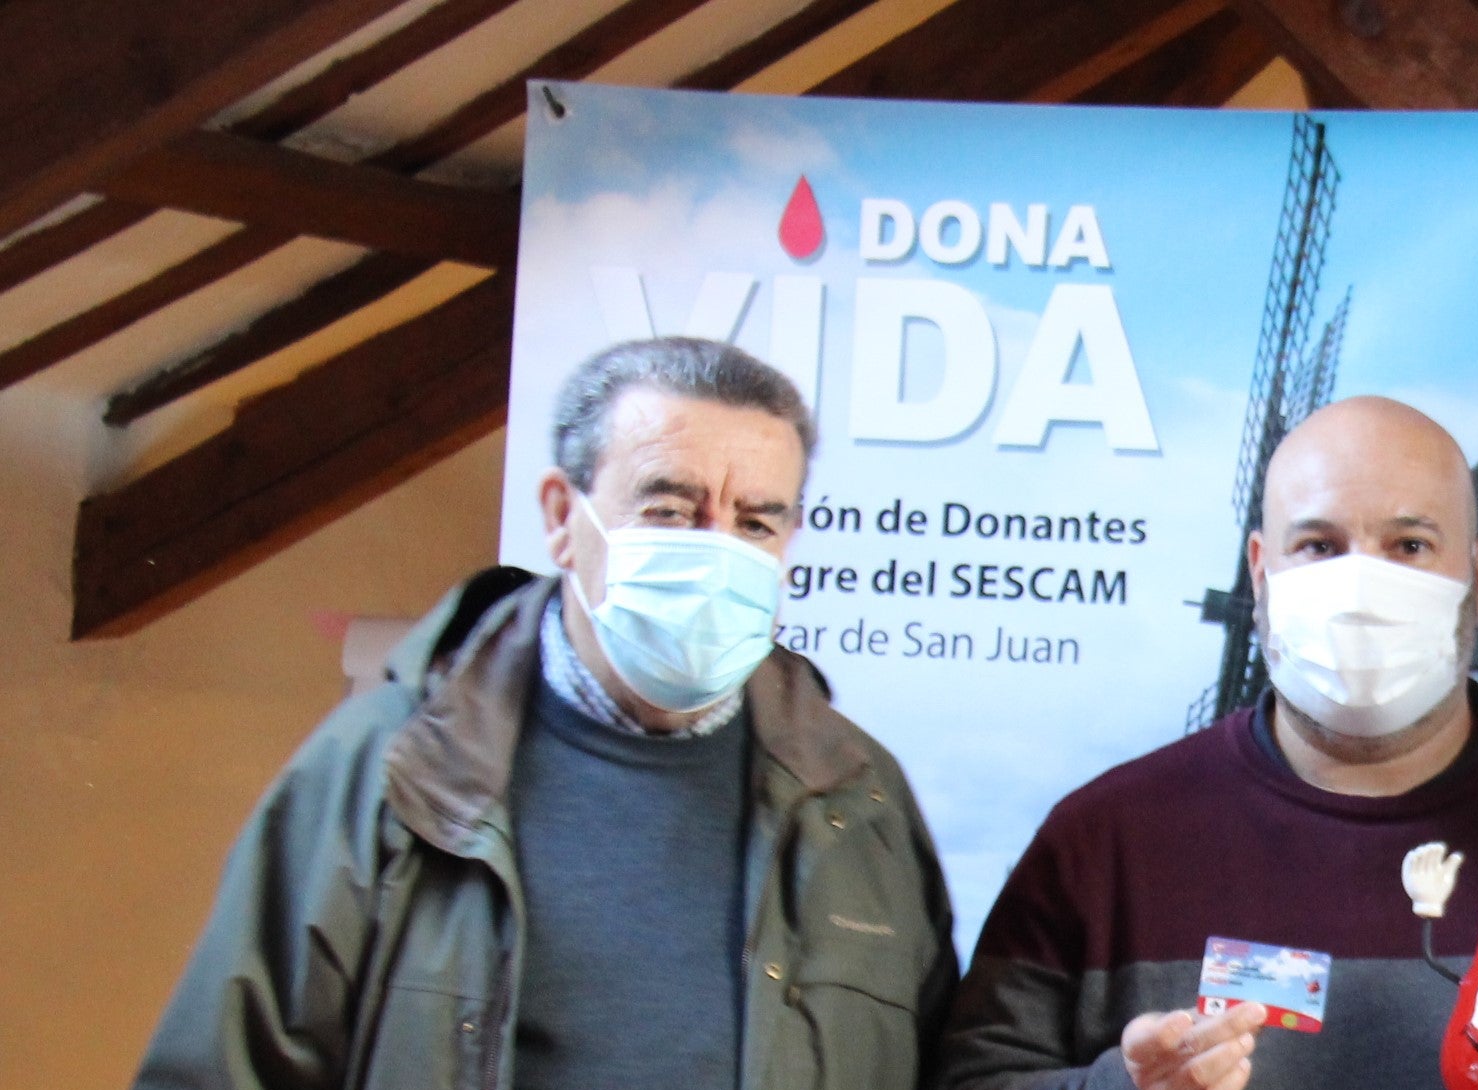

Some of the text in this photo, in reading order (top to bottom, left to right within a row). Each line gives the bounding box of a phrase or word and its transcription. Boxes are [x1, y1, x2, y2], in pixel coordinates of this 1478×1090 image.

[859, 198, 1114, 273] DONA
[876, 499, 928, 536] de
[942, 502, 1147, 545] Donantes
[788, 560, 1127, 605] gre del SESCAM
[775, 618, 1081, 665] zar de San Juan
